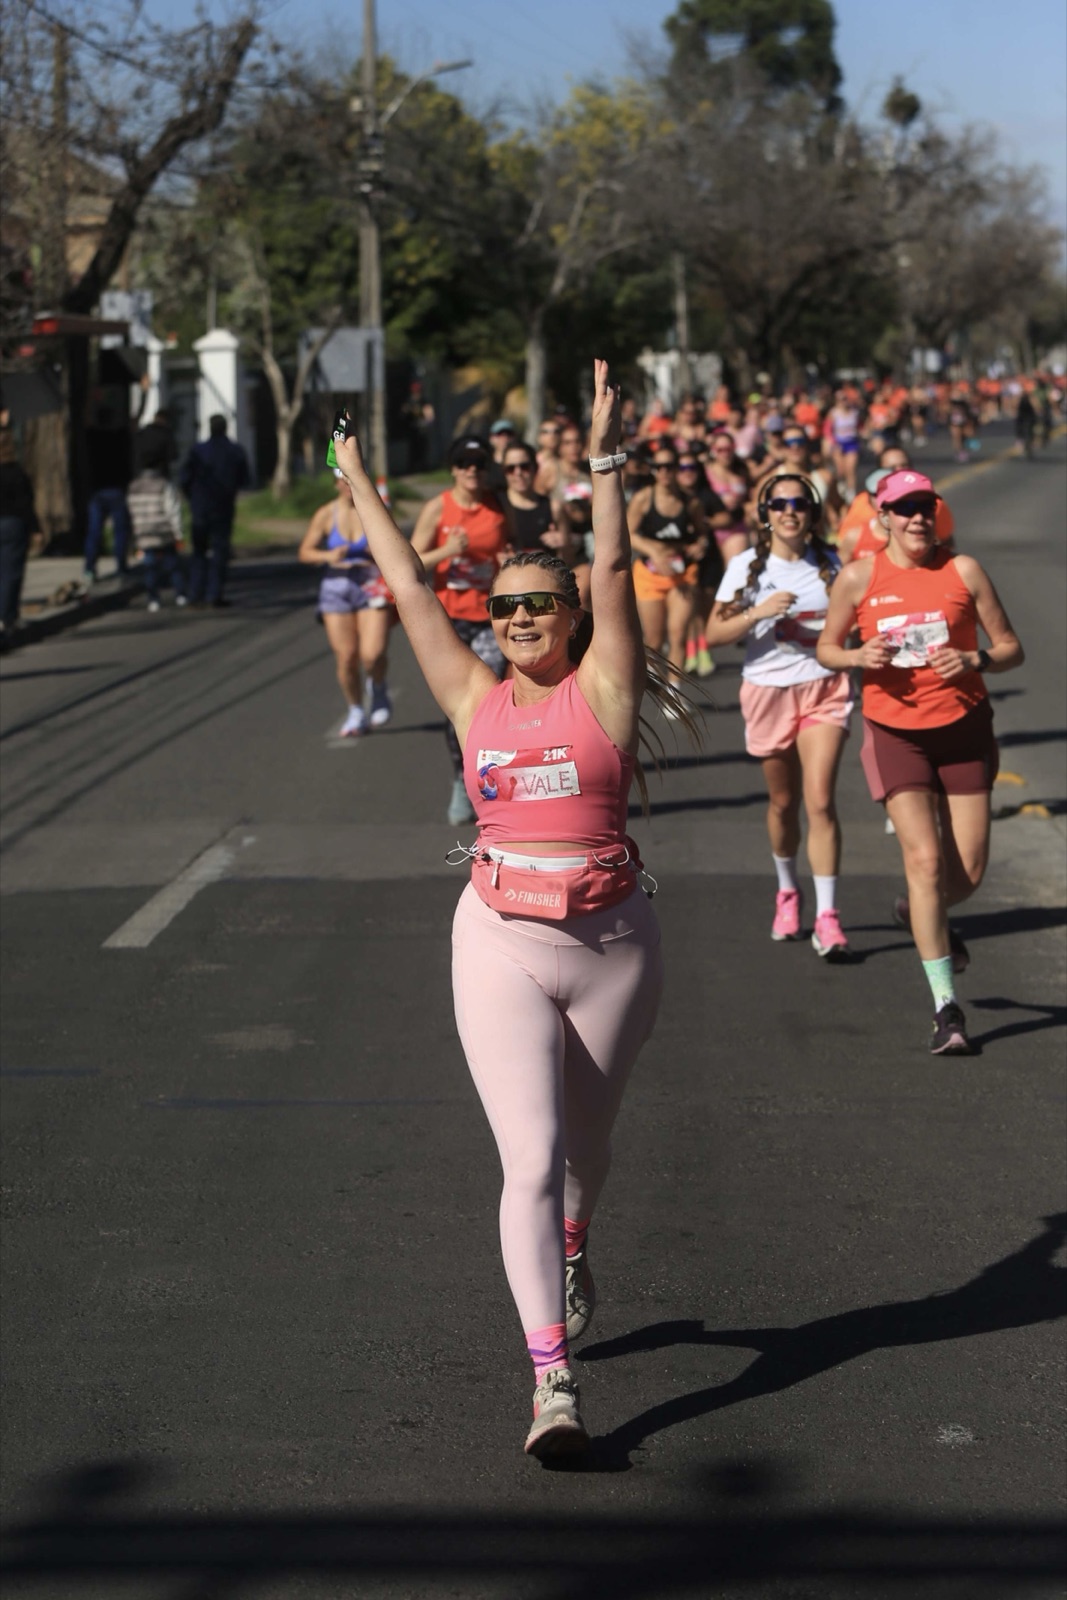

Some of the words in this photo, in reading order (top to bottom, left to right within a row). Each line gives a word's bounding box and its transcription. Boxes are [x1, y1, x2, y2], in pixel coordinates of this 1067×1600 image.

[542, 747, 568, 762] 21K
[521, 770, 574, 796] VALE
[517, 890, 561, 908] FINISHER
